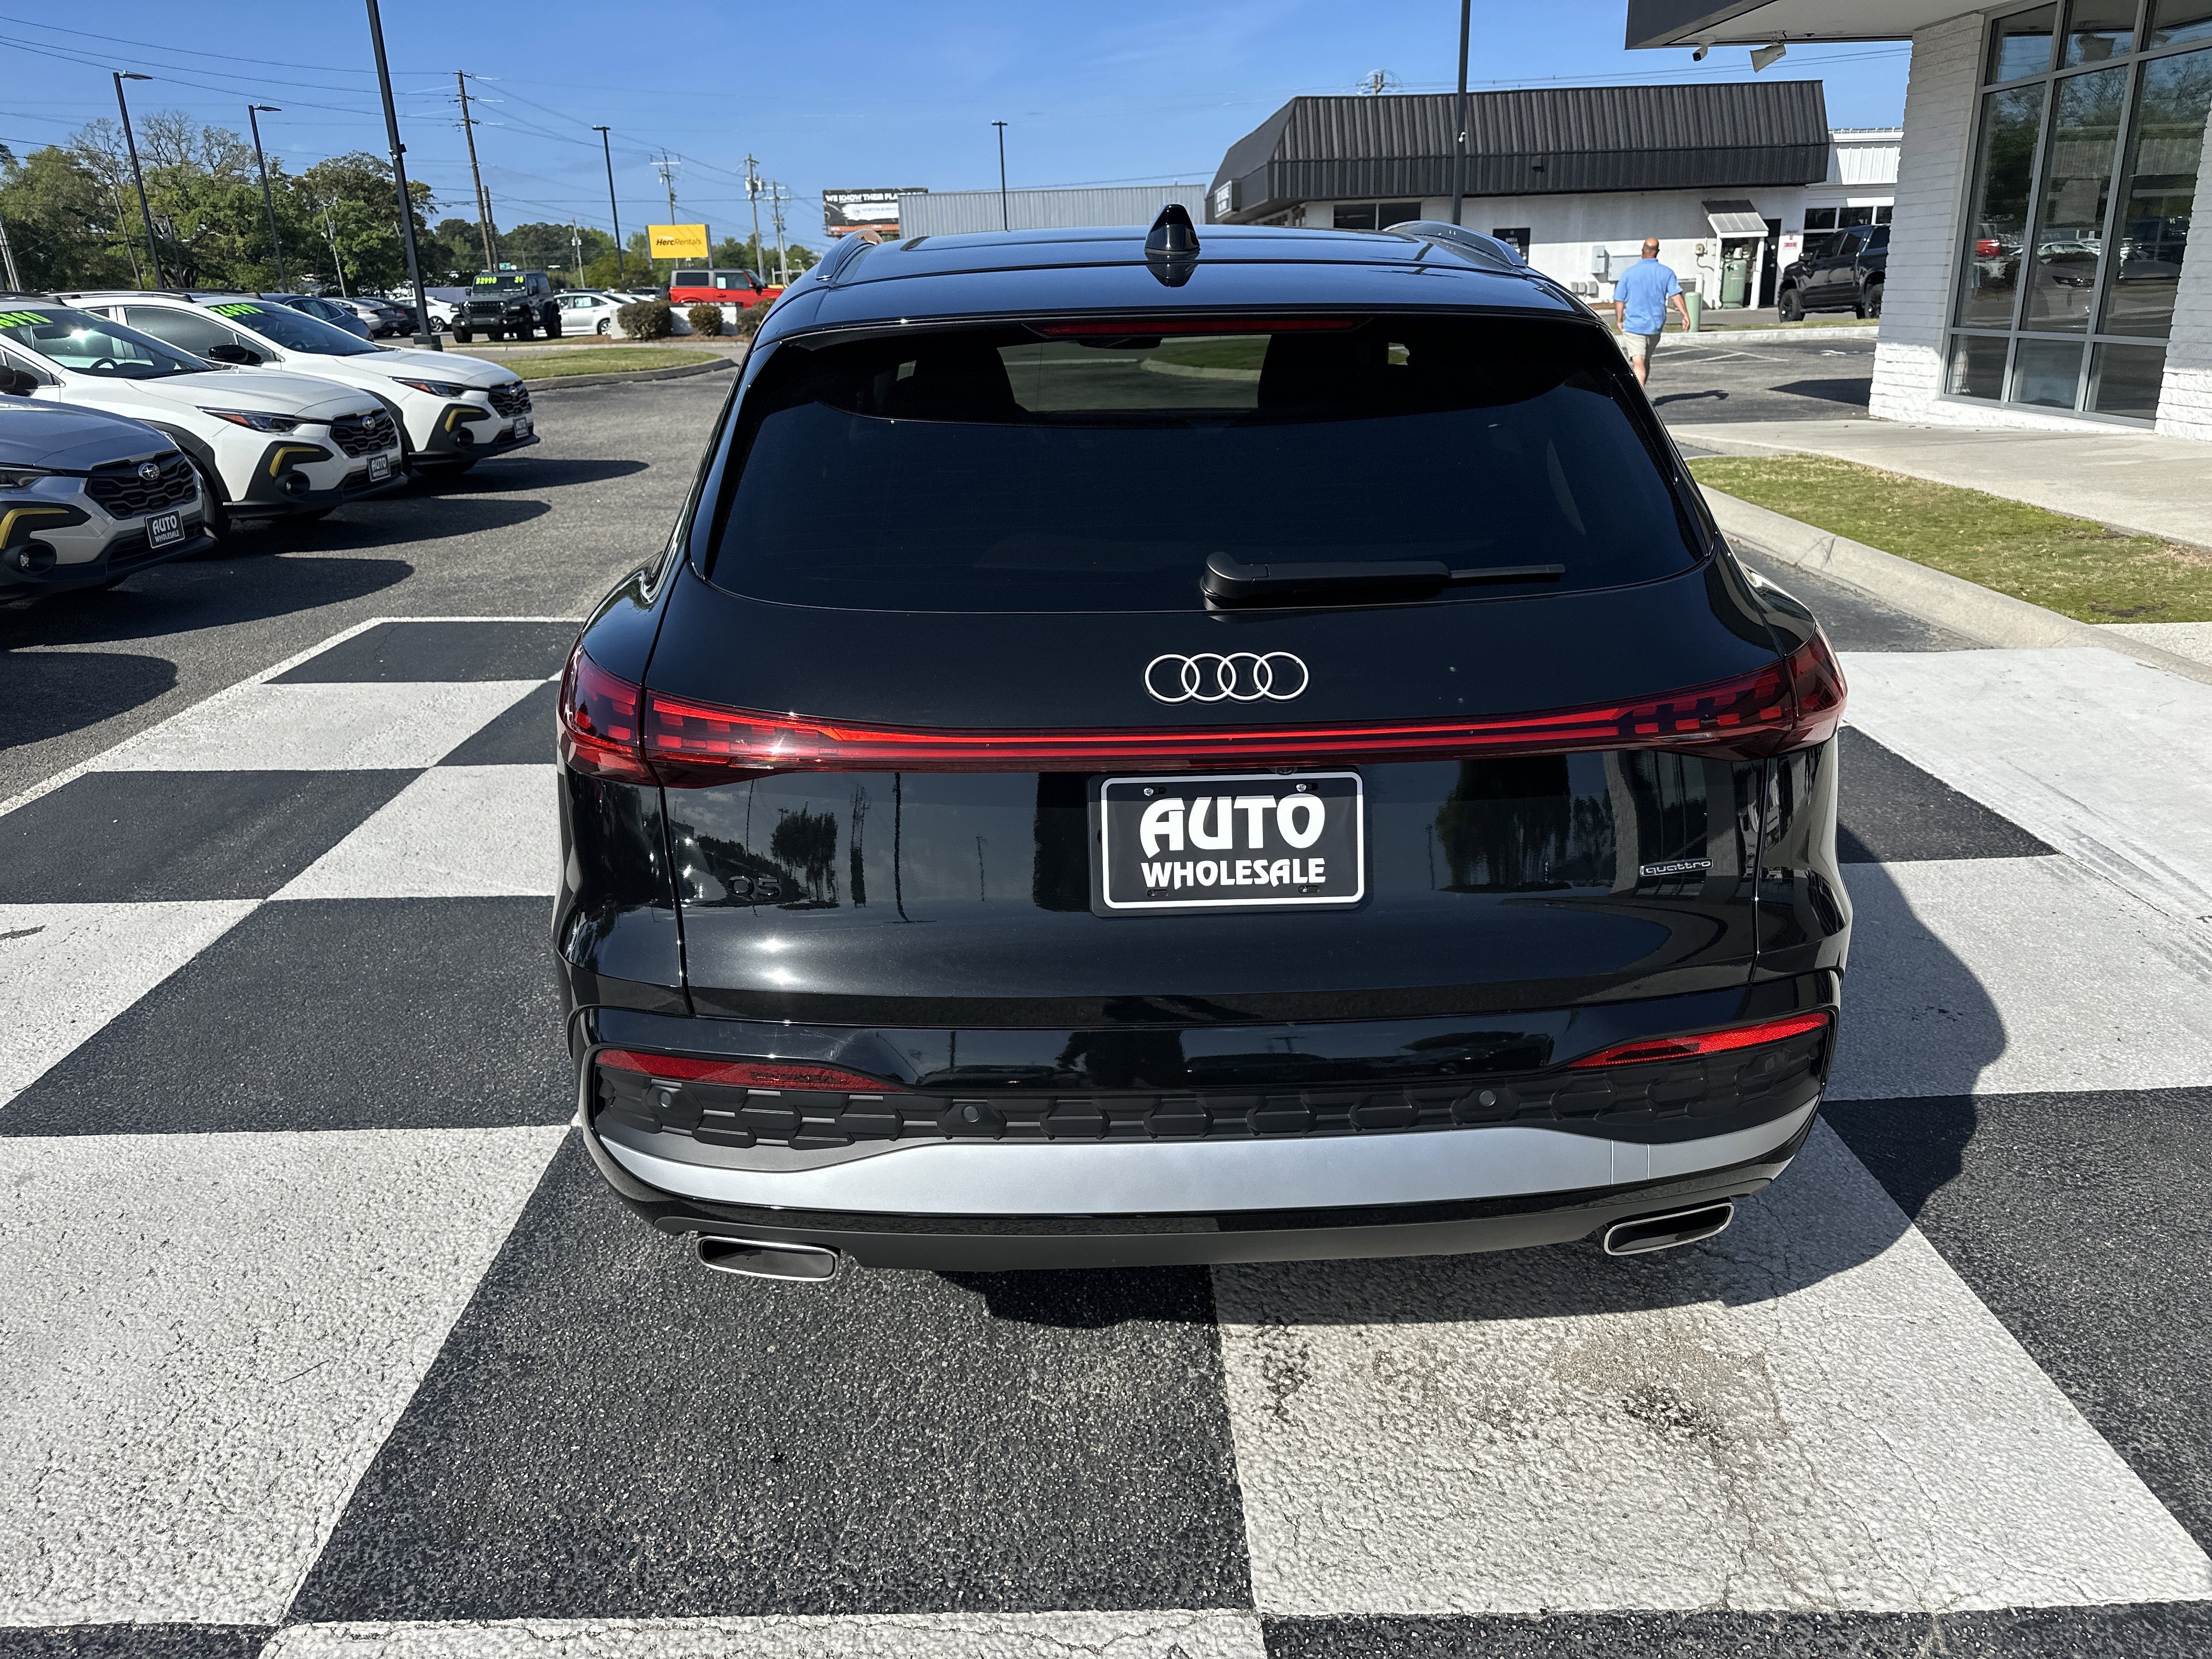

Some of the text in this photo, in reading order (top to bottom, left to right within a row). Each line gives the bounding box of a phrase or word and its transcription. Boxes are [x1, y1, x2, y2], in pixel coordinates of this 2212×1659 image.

[208, 303, 265, 317] 26990
[153, 515, 177, 535] AUTO
[155, 530, 179, 543] WHOLESALE
[1140, 793, 1325, 858] AUTO
[1141, 857, 1325, 889] WHOLESALE
[1646, 861, 1711, 874] quattro
[727, 876, 781, 901] Q5
